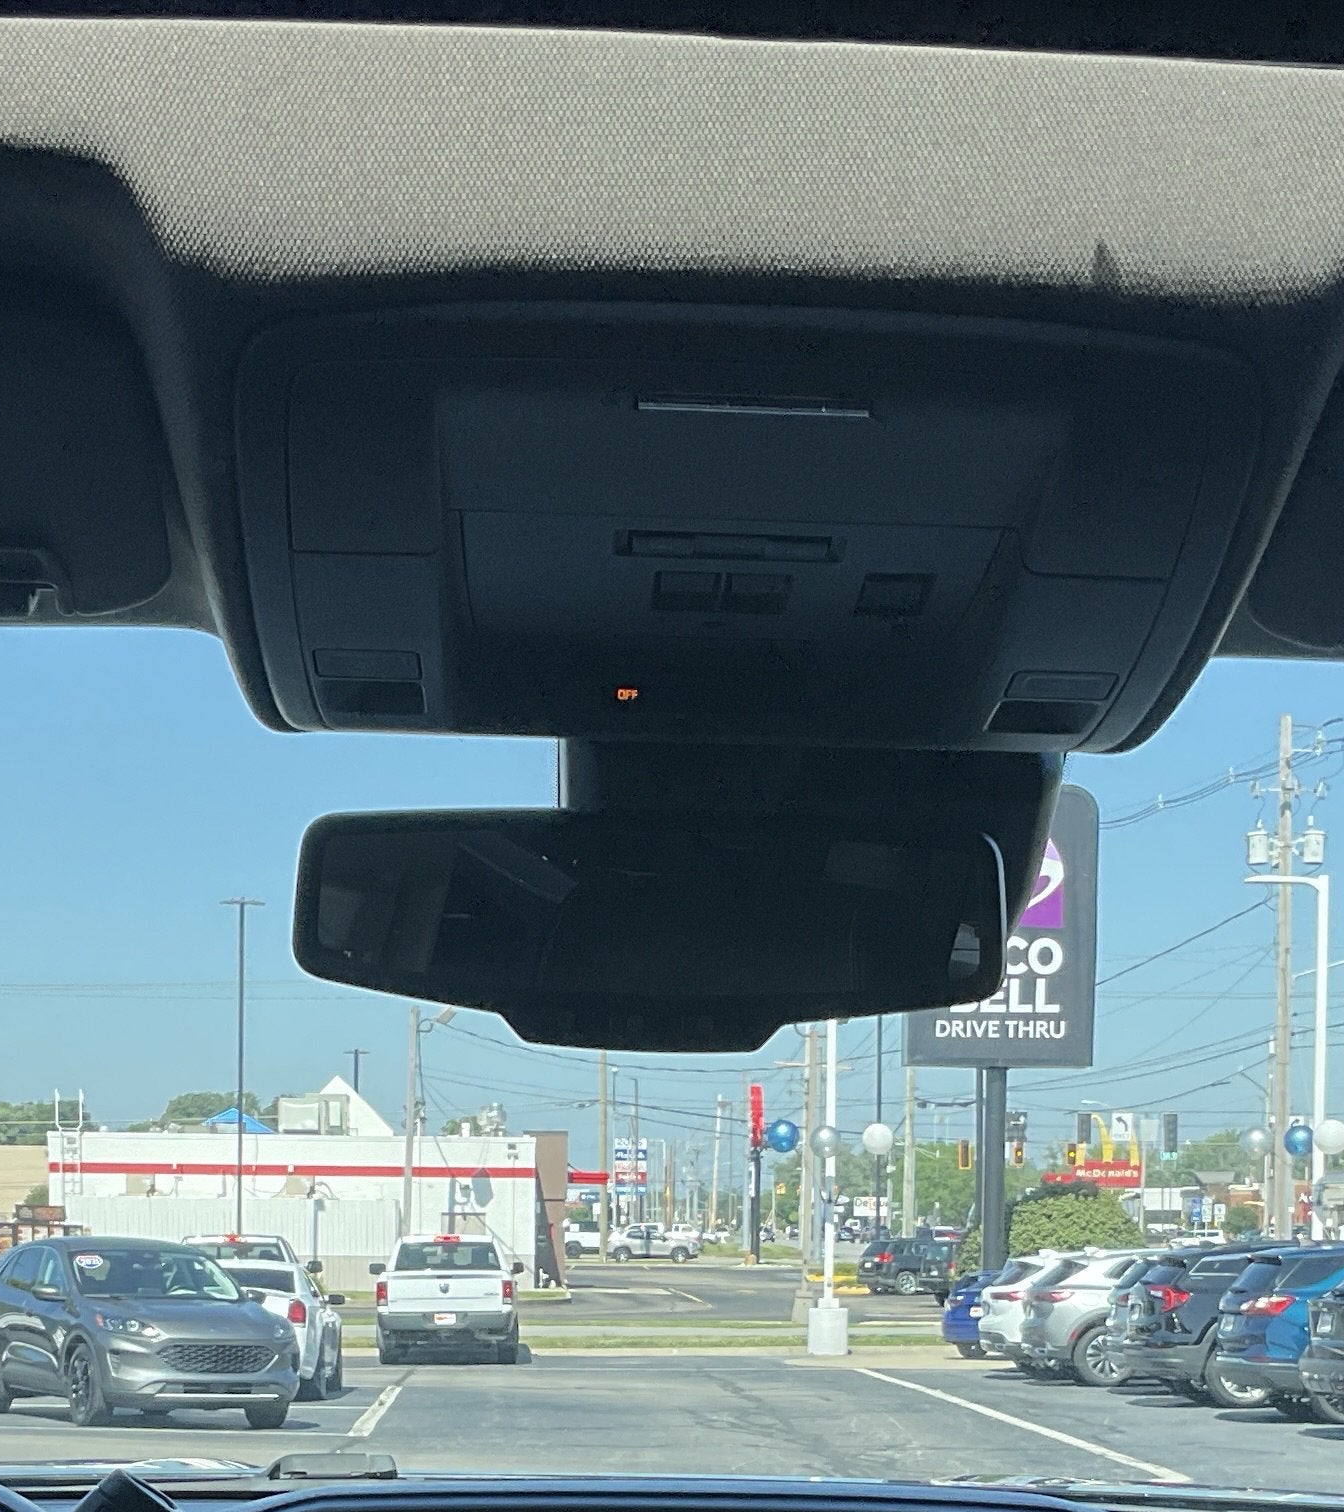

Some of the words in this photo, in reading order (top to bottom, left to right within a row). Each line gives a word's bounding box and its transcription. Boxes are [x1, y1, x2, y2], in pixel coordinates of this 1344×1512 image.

[617, 688, 638, 700] OFF
[1006, 936, 1064, 976] CO
[949, 978, 1061, 1015] ELL
[935, 1019, 1000, 1039] DRIVE
[1005, 1019, 1066, 1040] THRU
